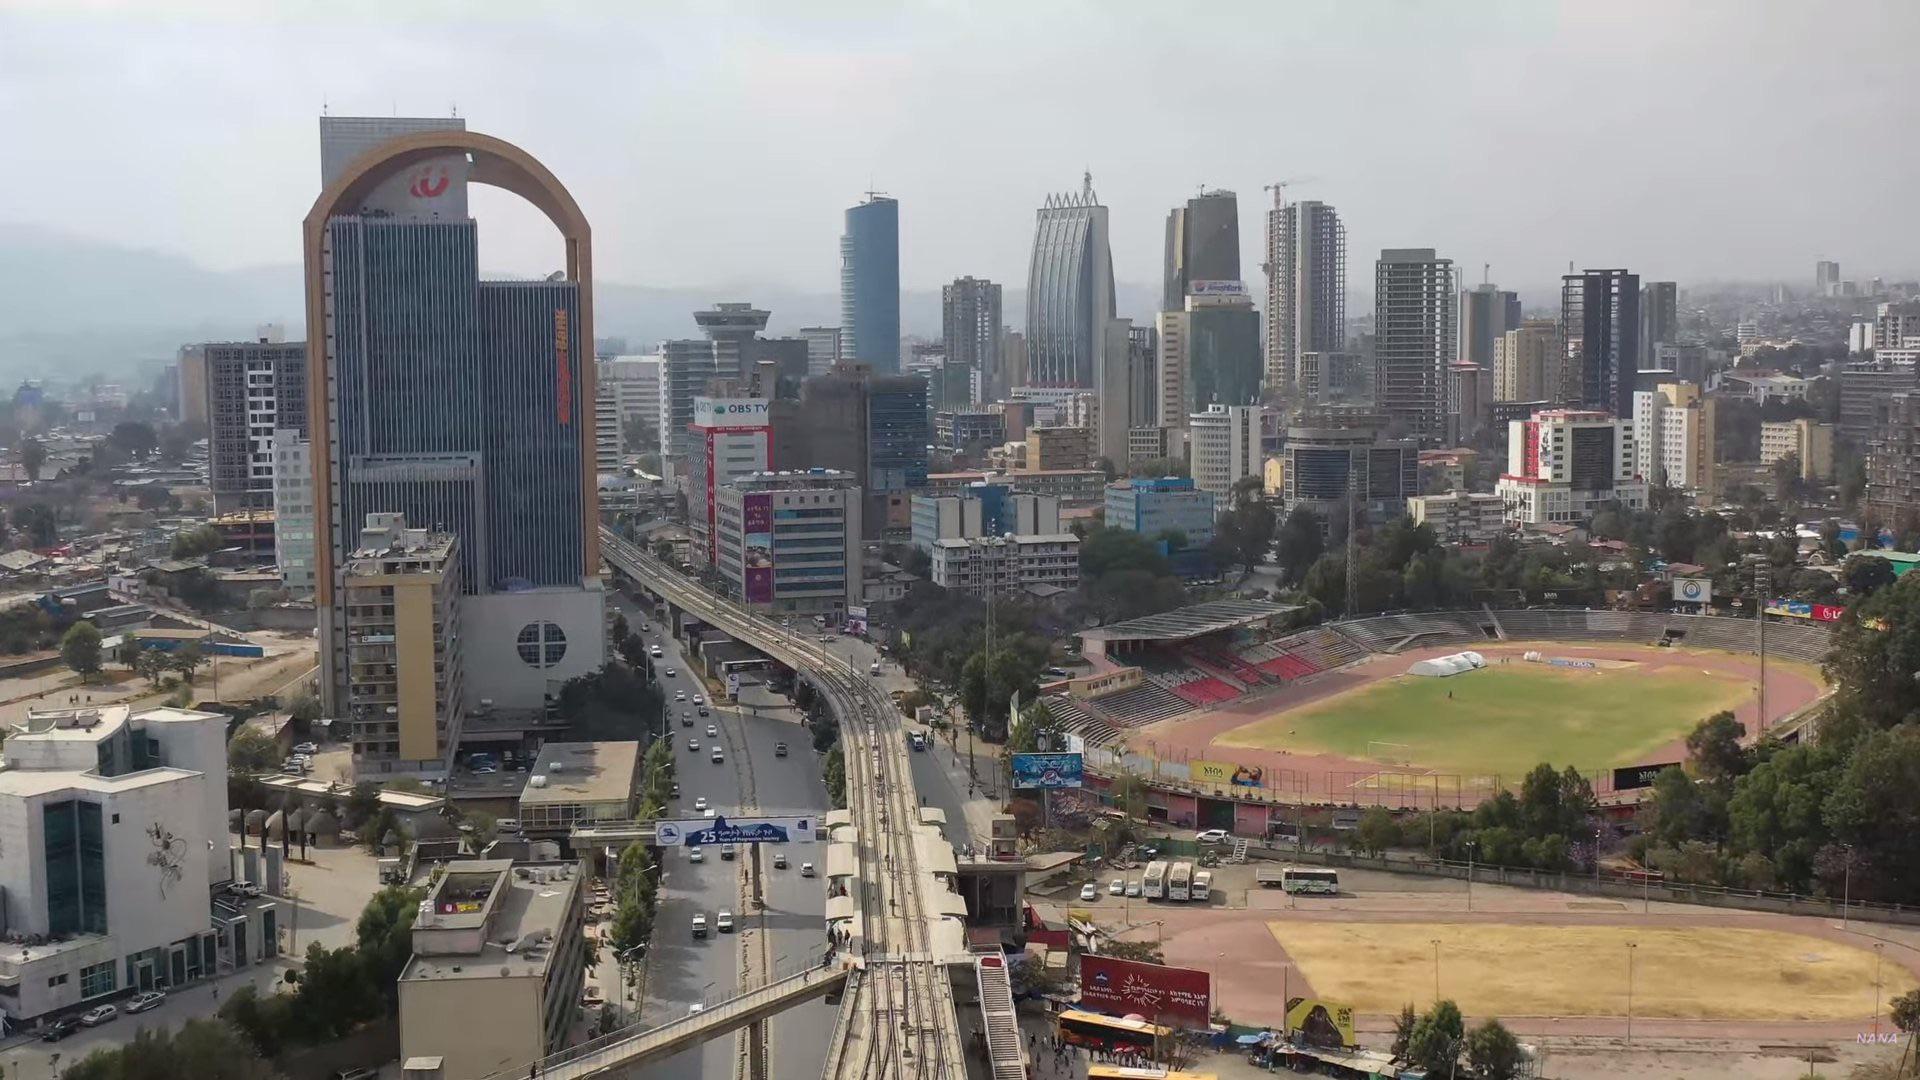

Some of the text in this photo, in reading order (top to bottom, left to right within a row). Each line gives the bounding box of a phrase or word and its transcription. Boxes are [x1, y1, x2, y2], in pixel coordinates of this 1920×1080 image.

[728, 404, 769, 413] OBS TV
[700, 831, 716, 843] 25
